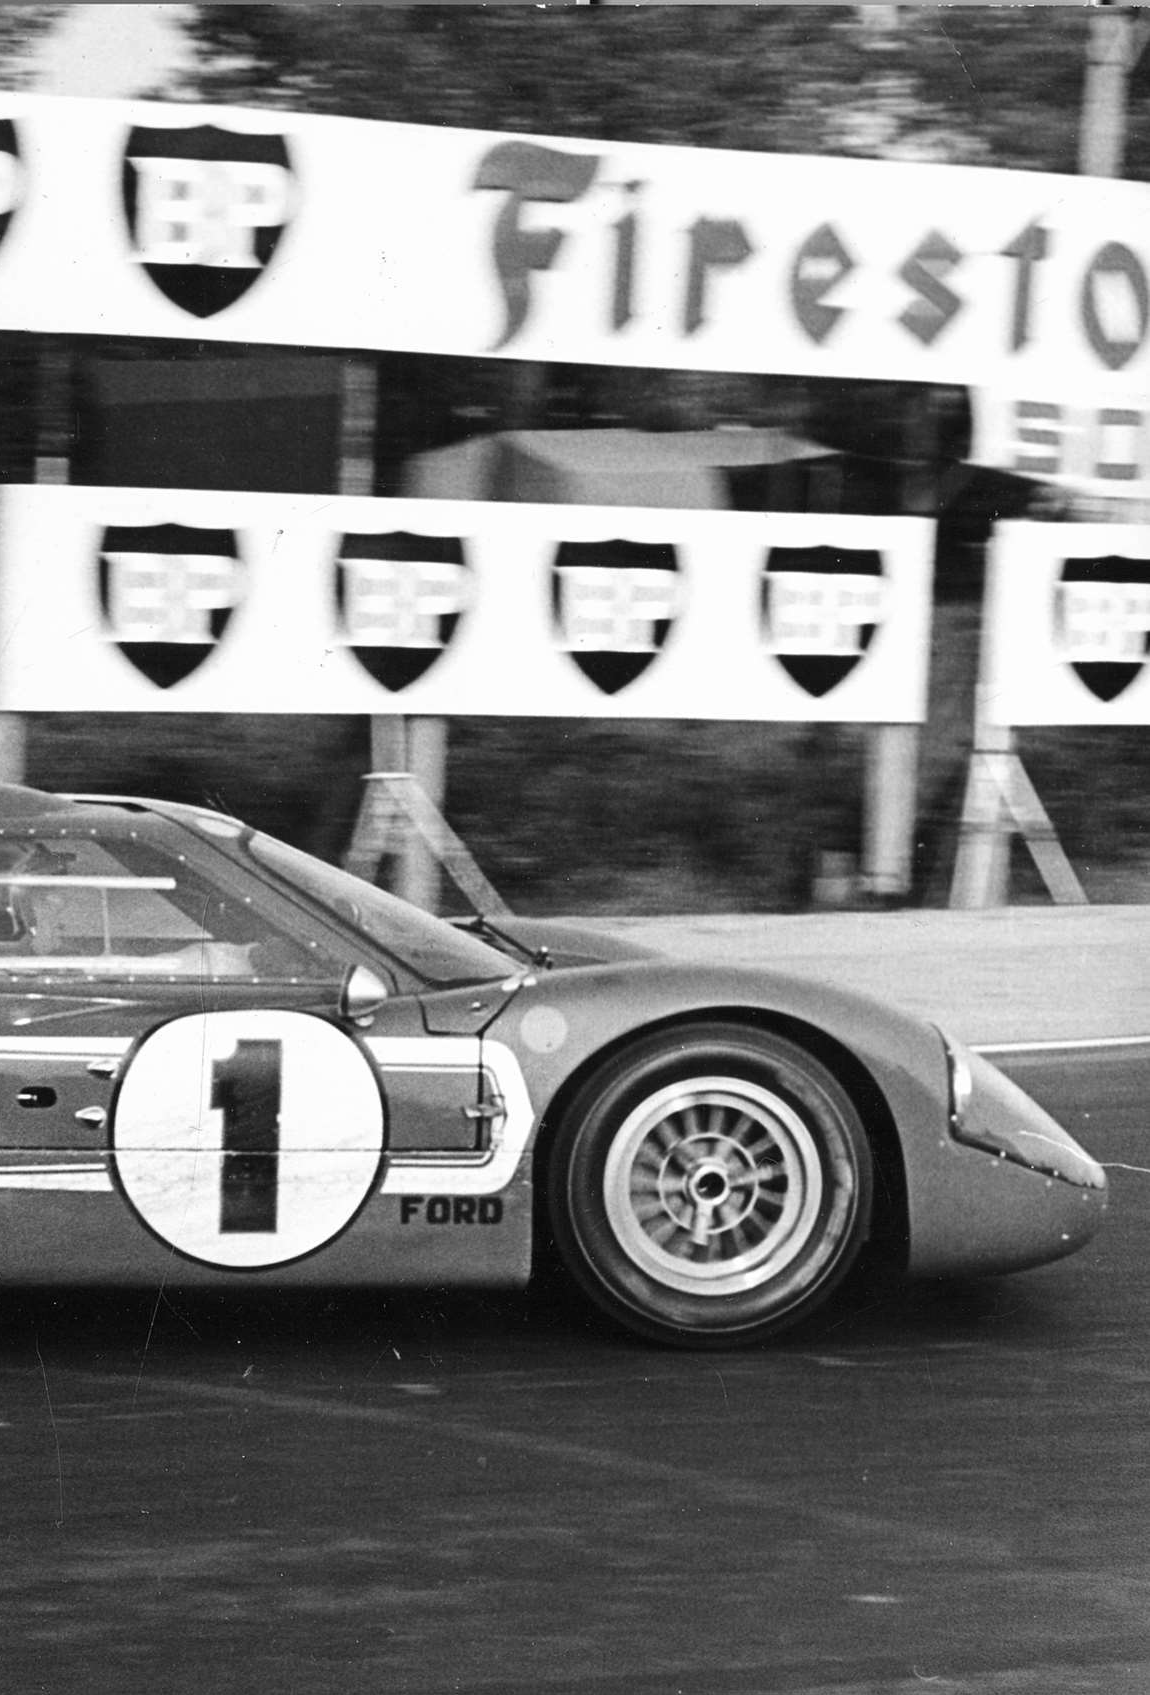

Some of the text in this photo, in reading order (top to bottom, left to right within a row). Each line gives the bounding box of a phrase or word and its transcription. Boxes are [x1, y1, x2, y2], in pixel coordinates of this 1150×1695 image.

[126, 156, 295, 268] BP
[100, 552, 246, 643] BP
[334, 559, 474, 647] BP
[552, 566, 688, 653] BP
[761, 571, 890, 656] BP
[210, 1038, 282, 1234] 1
[400, 1196, 503, 1225] FORD
